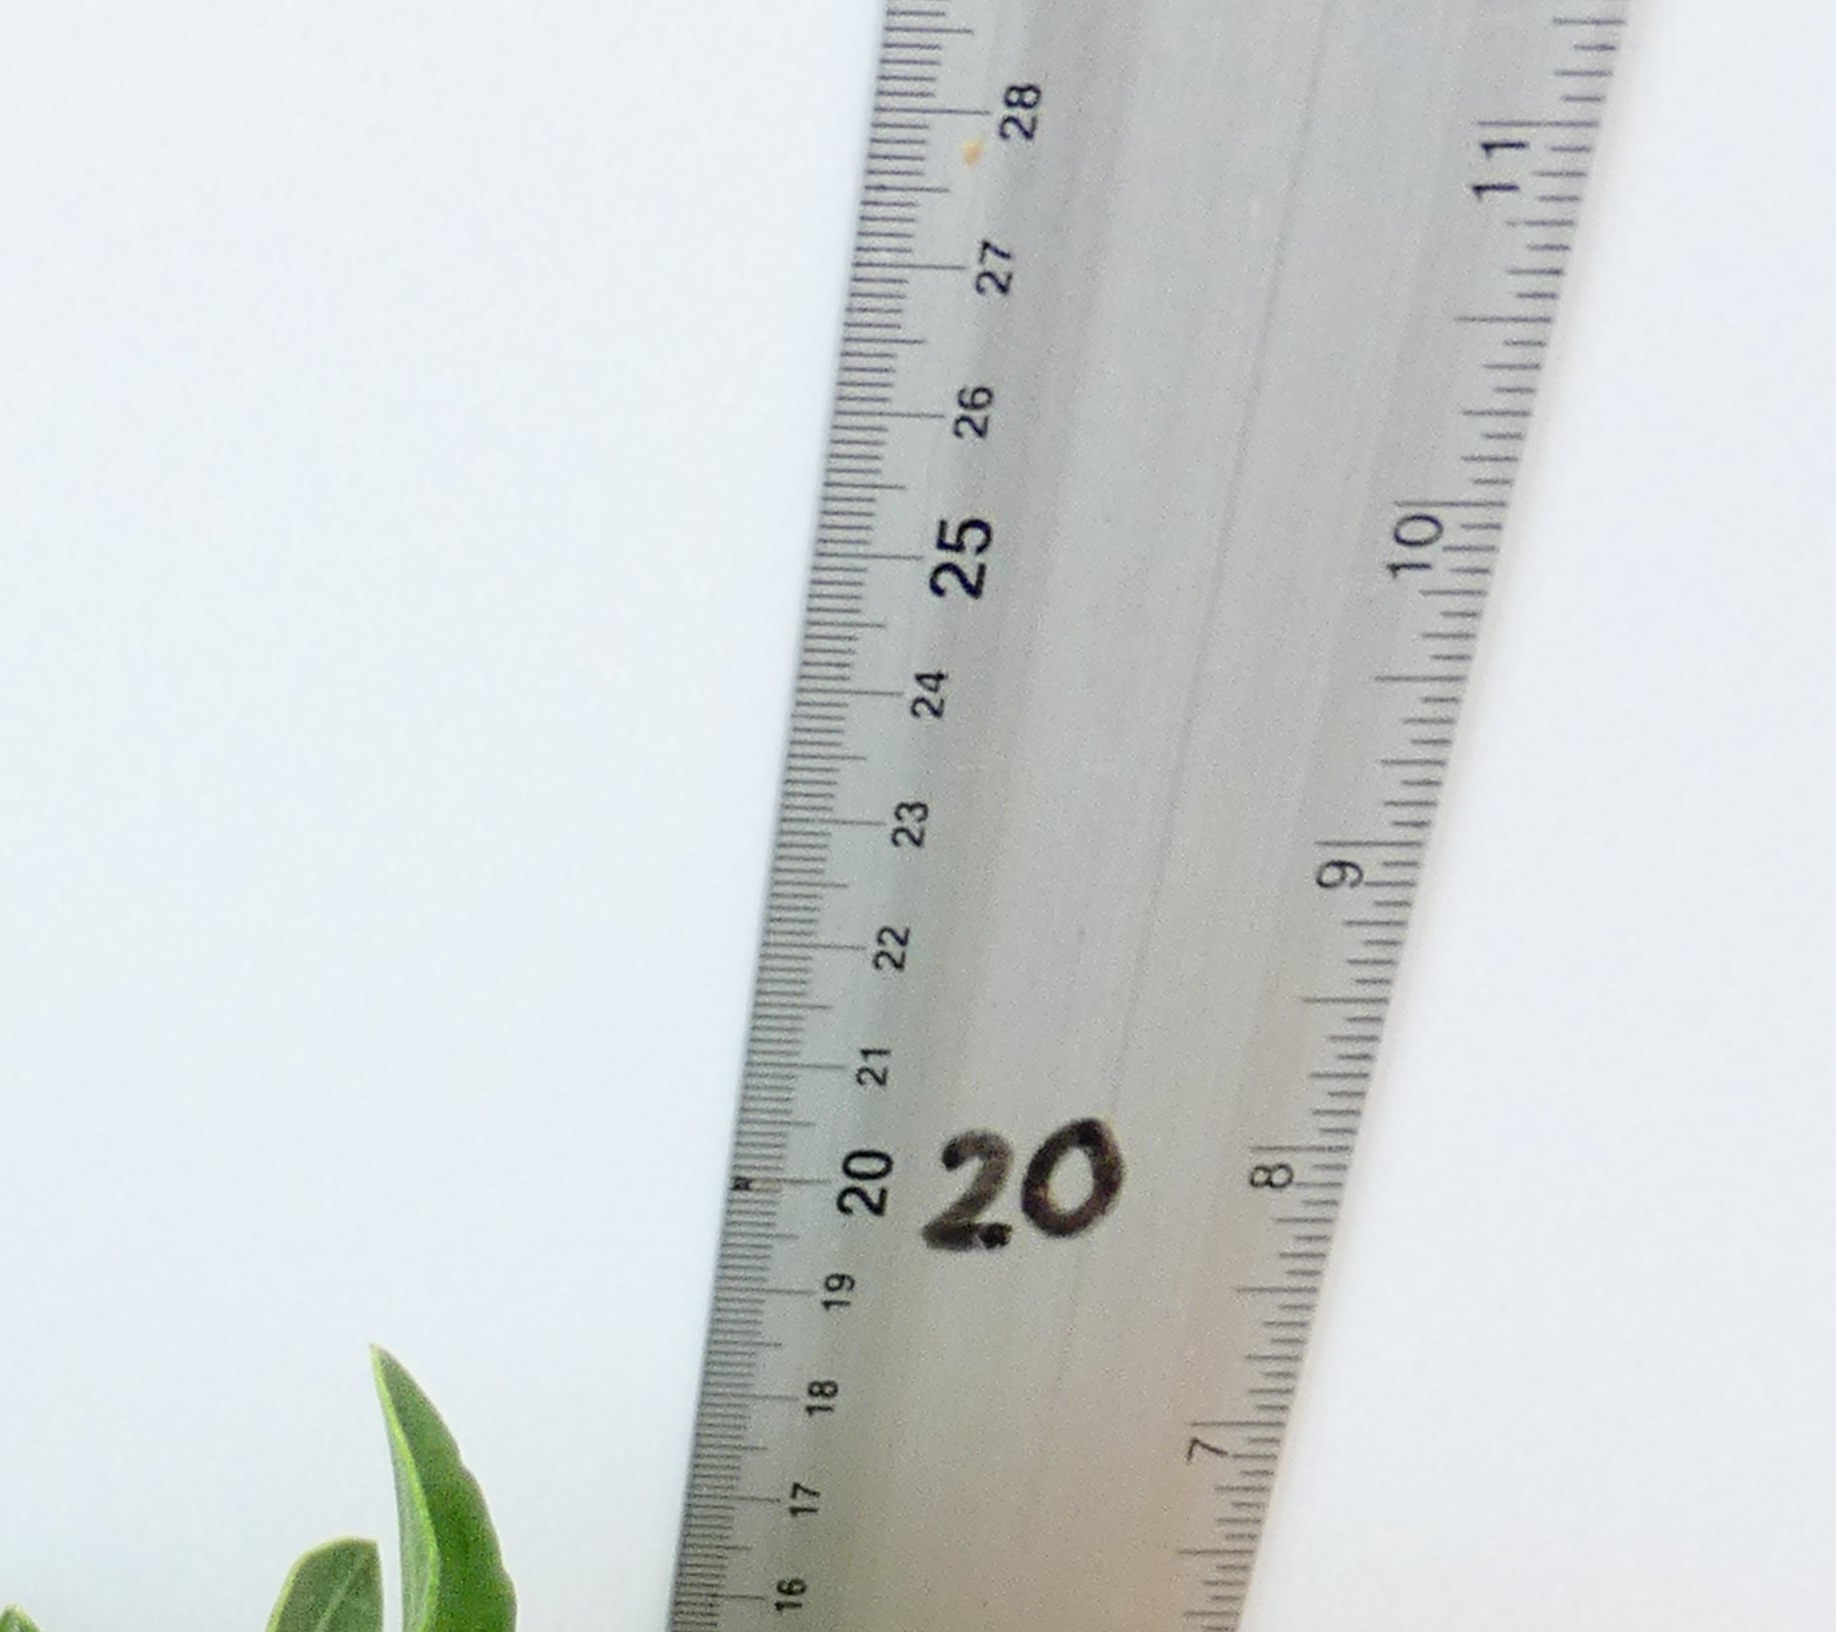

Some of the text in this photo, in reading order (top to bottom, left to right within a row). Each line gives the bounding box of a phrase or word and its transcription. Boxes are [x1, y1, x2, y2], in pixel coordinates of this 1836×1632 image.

[999, 83, 1042, 141] 28
[1471, 141, 1528, 199] 11
[975, 240, 1013, 296] 27
[953, 386, 994, 439] 26
[929, 518, 993, 600] 25
[1386, 514, 1444, 579] 10
[910, 671, 948, 719] 24
[890, 801, 929, 848] 23
[1315, 859, 1364, 889] 9
[872, 926, 911, 972] 22
[854, 1047, 891, 1087] 21
[836, 1149, 894, 1217] 20
[921, 1118, 1123, 1252] 20
[1248, 1163, 1294, 1190] 8
[821, 1273, 856, 1311] 19
[805, 1380, 839, 1417] 18
[1186, 1436, 1229, 1462] 7
[788, 1482, 821, 1518] 17
[774, 1578, 807, 1612] 16
